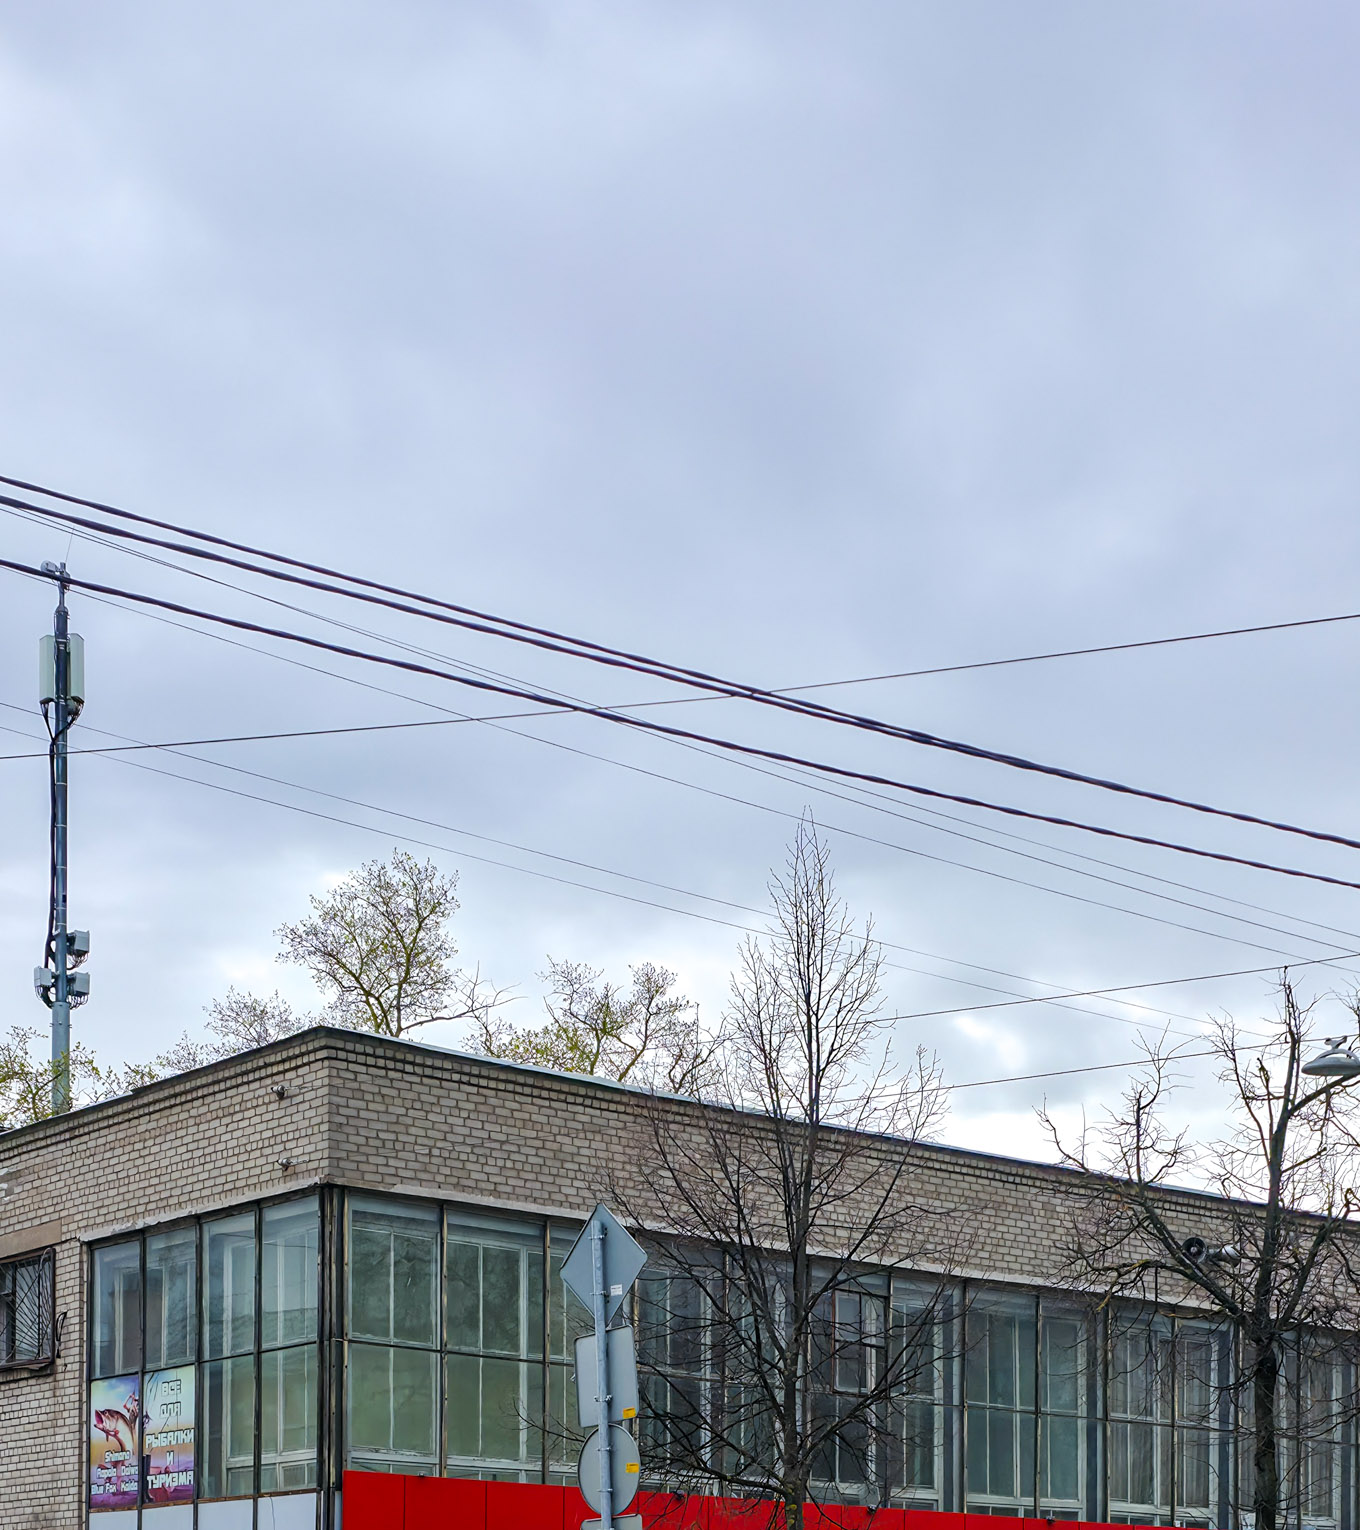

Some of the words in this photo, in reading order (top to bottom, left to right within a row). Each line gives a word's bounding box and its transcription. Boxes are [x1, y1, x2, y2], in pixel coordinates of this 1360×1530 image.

[161, 1379, 181, 1396] ВСЕ
[160, 1401, 181, 1418] ДЛЯ
[145, 1428, 194, 1448] РЫБАЛКИ
[104, 1450, 130, 1463] Shimano
[166, 1450, 174, 1465] И
[146, 1470, 194, 1489] ТУРИЗМА
